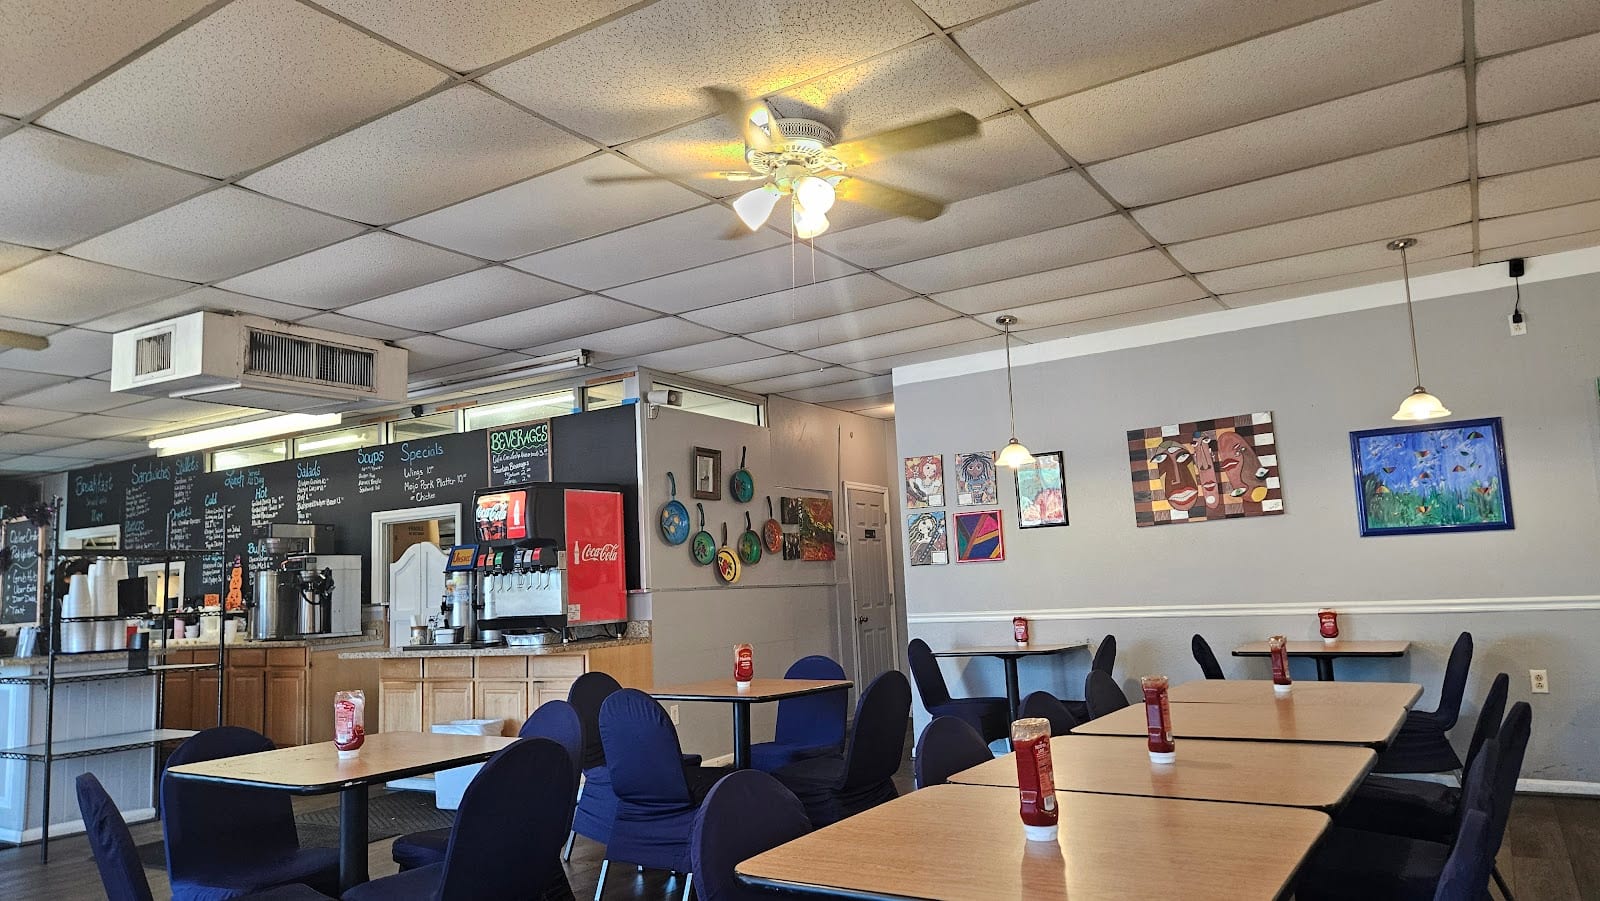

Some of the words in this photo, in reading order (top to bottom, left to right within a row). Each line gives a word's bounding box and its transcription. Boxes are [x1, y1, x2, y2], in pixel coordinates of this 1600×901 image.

[491, 424, 548, 451] BEVERAGES
[357, 448, 384, 466] Soups
[400, 442, 444, 466] Specials
[130, 461, 171, 486] Sandwiches
[296, 460, 321, 479] Salads
[403, 467, 424, 481] Wings
[255, 486, 268, 500] Hot
[404, 481, 419, 493] Mojo
[420, 479, 434, 490] Pork
[204, 492, 218, 507] Cold
[581, 543, 619, 562] Coca-Cola
